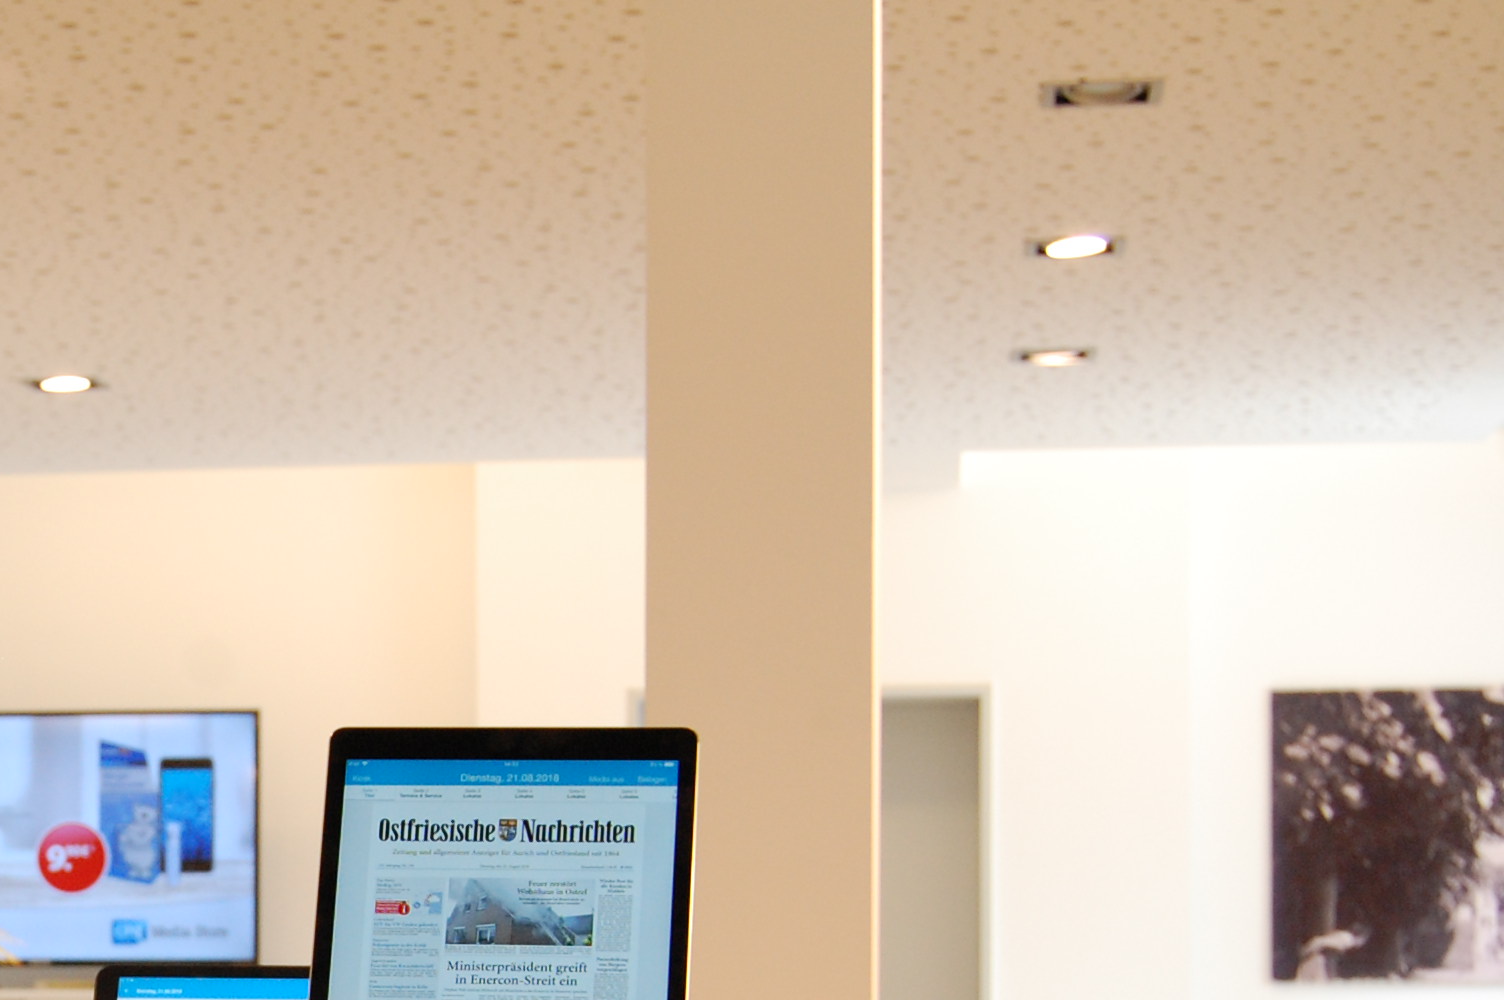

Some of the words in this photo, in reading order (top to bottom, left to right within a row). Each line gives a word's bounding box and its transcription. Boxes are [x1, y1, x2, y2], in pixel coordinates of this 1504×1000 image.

[460, 774, 504, 783] Dienstag,
[506, 774, 560, 783] 21.08.2018
[378, 818, 496, 842] Ostfriesische
[520, 819, 635, 843] Nachrichten
[446, 960, 552, 974] Ministerpräsident
[556, 962, 588, 975] greift
[455, 974, 467, 984] in
[470, 974, 556, 986] Enercon-Streit
[559, 976, 578, 986] ein
